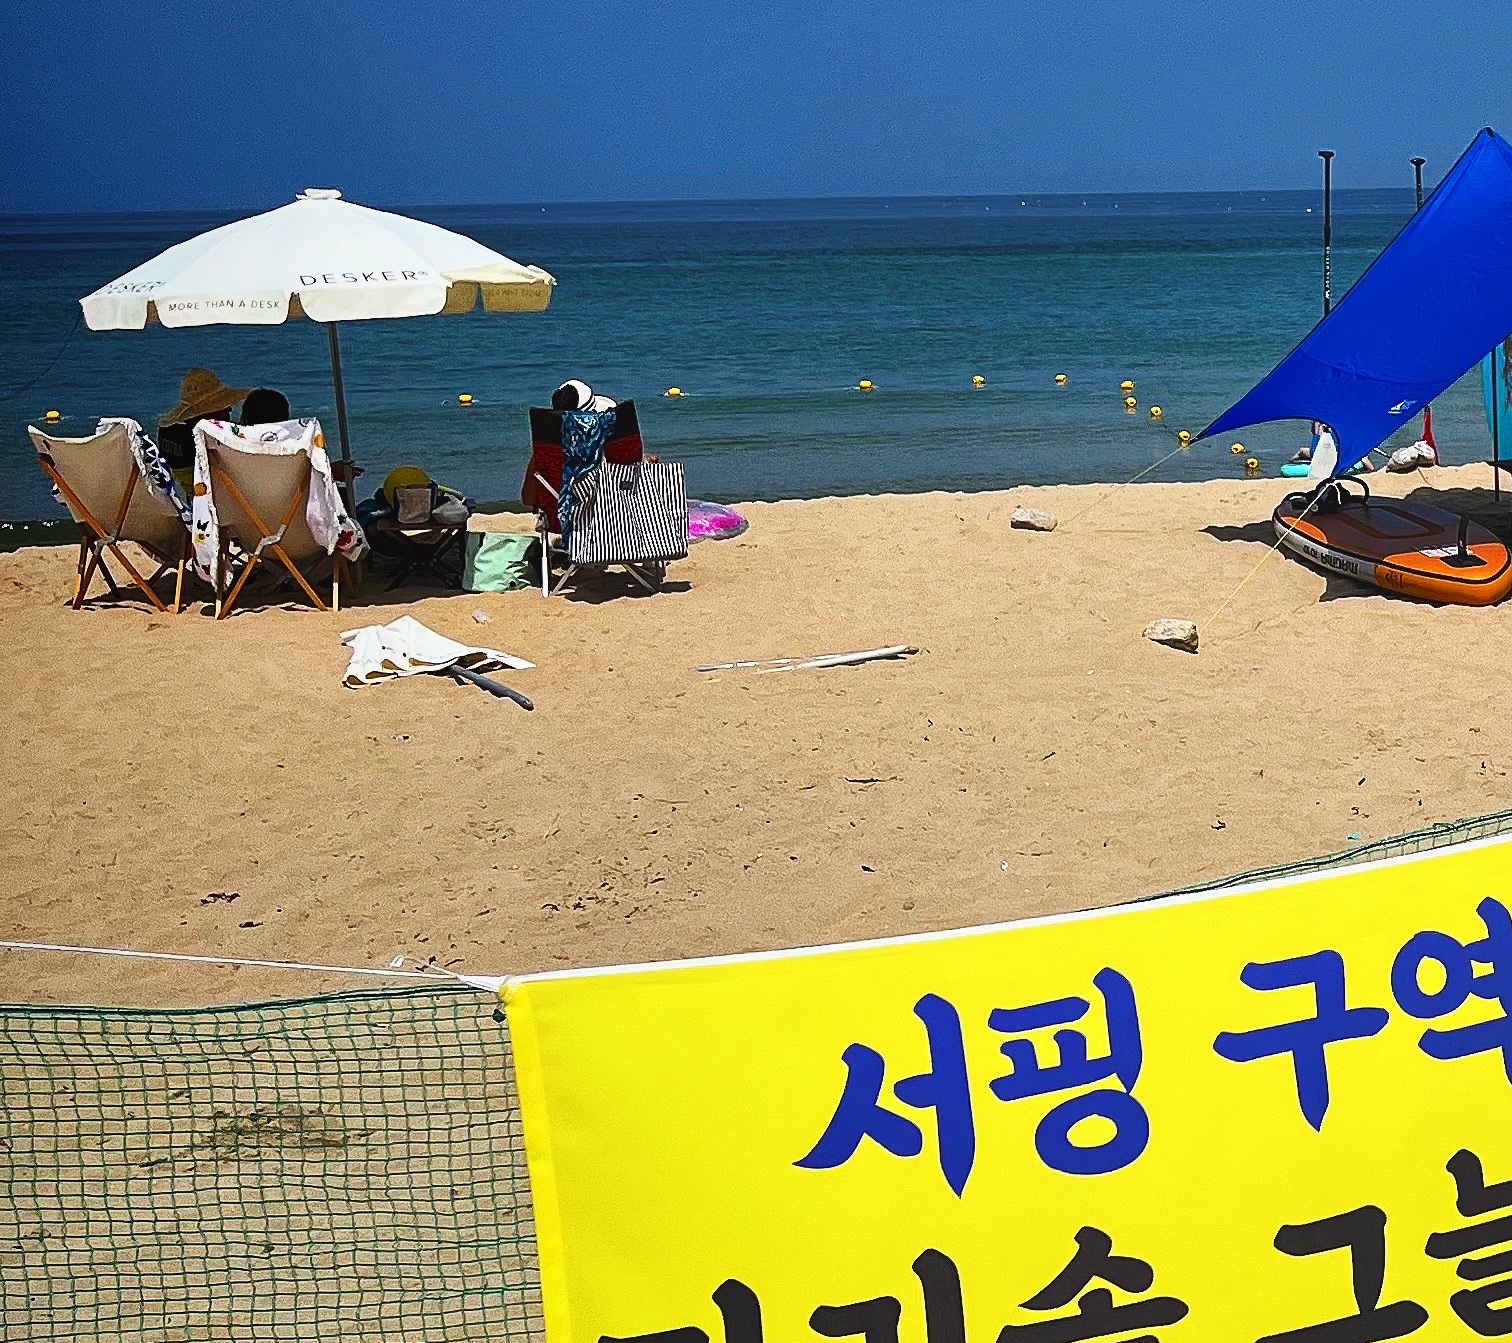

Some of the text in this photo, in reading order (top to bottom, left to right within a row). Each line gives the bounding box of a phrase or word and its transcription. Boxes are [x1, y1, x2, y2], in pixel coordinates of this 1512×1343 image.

[168, 299, 280, 312] MORE THAN A DESK
[795, 967, 1151, 1197] 서핑
